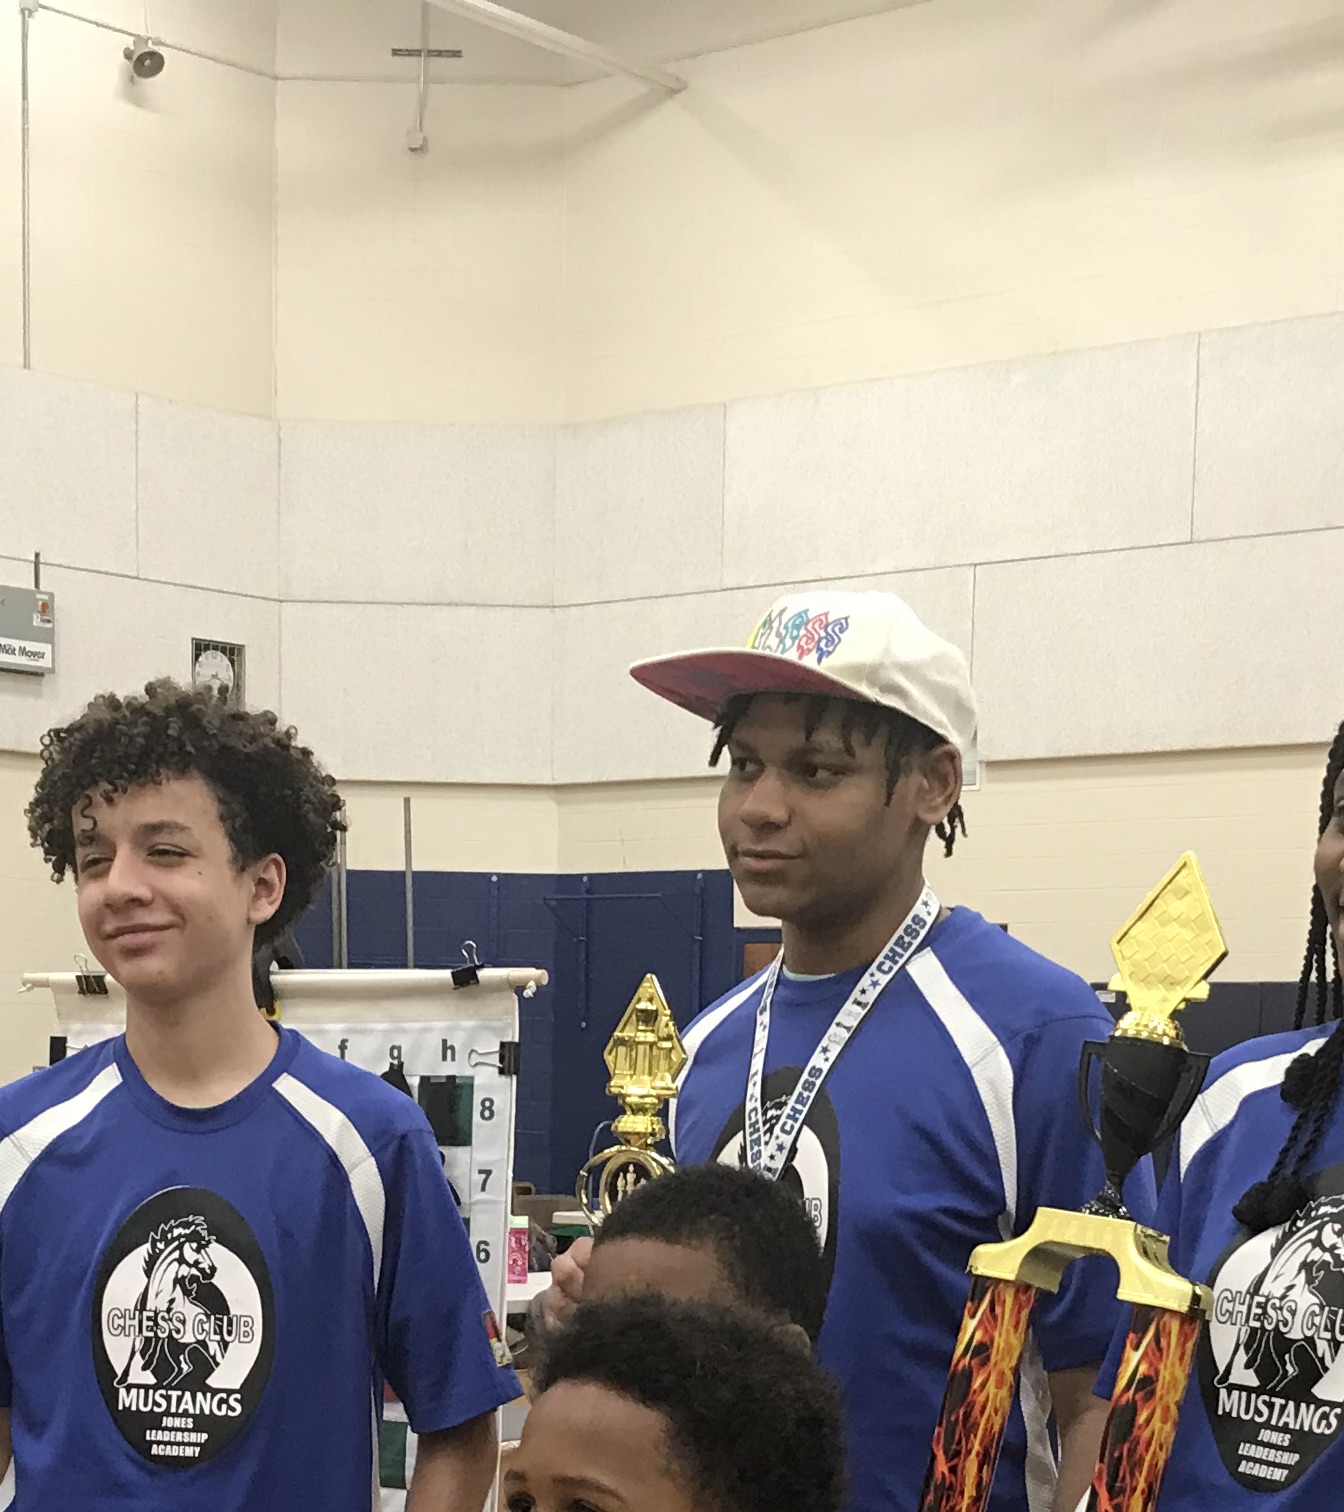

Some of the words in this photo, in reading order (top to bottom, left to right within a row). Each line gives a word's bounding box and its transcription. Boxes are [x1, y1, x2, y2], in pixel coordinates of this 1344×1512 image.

[18, 645, 46, 660] Mover
[876, 913, 927, 976] CHESS
[338, 1038, 349, 1060] f
[389, 1044, 402, 1067] g
[441, 1039, 456, 1062] h
[479, 1097, 495, 1121] 8
[780, 1065, 824, 1136] CHESS
[477, 1169, 493, 1192] 7
[476, 1240, 491, 1264] 6
[1214, 1288, 1298, 1335] CHESS
[107, 1307, 185, 1340] CHESS
[192, 1313, 255, 1343] CLUB
[118, 1387, 243, 1417] MUSTANGS
[1217, 1387, 1342, 1436] MUSTANGS
[162, 1417, 194, 1429] JONES
[146, 1430, 208, 1444] LEADERSHIP
[1257, 1428, 1292, 1447] JONES
[151, 1444, 201, 1457] ACADEMY
[1238, 1441, 1300, 1466] LEADERSHIP
[1238, 1460, 1289, 1483] ACADEMY
